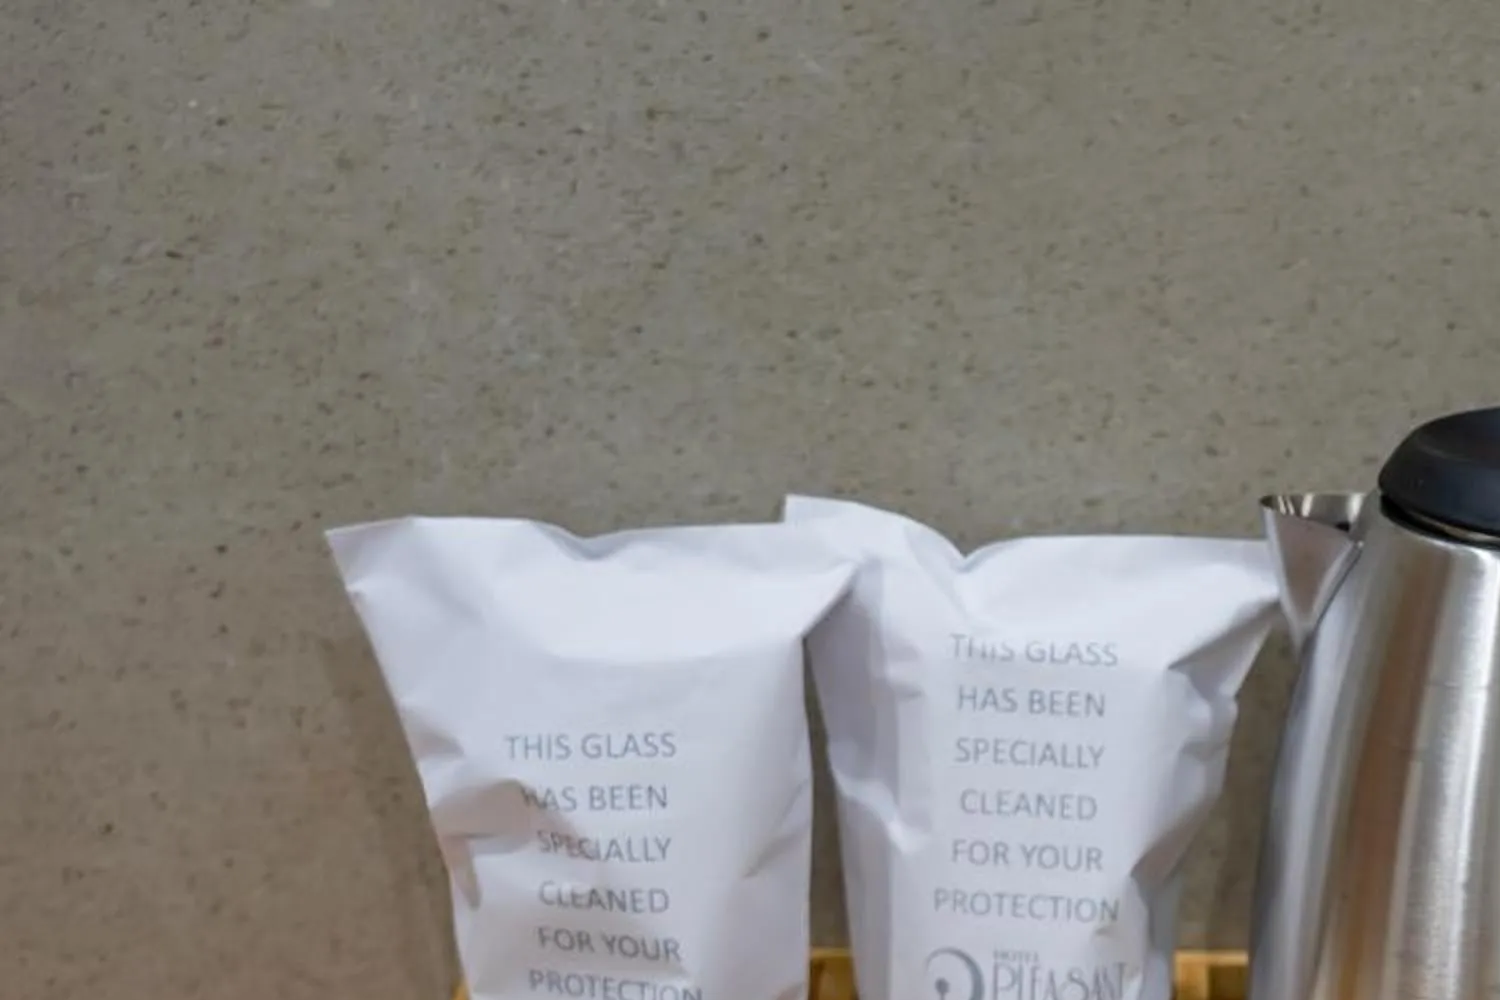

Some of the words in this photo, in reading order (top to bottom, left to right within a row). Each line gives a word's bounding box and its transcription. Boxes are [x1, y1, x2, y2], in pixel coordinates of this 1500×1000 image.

[950, 633, 1015, 662] THIS
[1024, 641, 1118, 667] GLASS
[957, 685, 1018, 713] HAS
[1028, 689, 1106, 717] BEEN
[504, 734, 573, 761] THIS
[581, 732, 677, 760] GLASS
[954, 736, 1105, 769] SPECIALLY
[588, 785, 668, 811] BEEN
[960, 788, 1098, 821] CLEANED
[536, 829, 672, 863] SPECIALLY
[952, 839, 1010, 866] FOR
[1019, 844, 1104, 872] YOUR
[538, 881, 670, 914] CLEANED
[934, 887, 1120, 923] PROTECTION
[537, 926, 596, 953] FOR
[601, 933, 682, 964] YOUR
